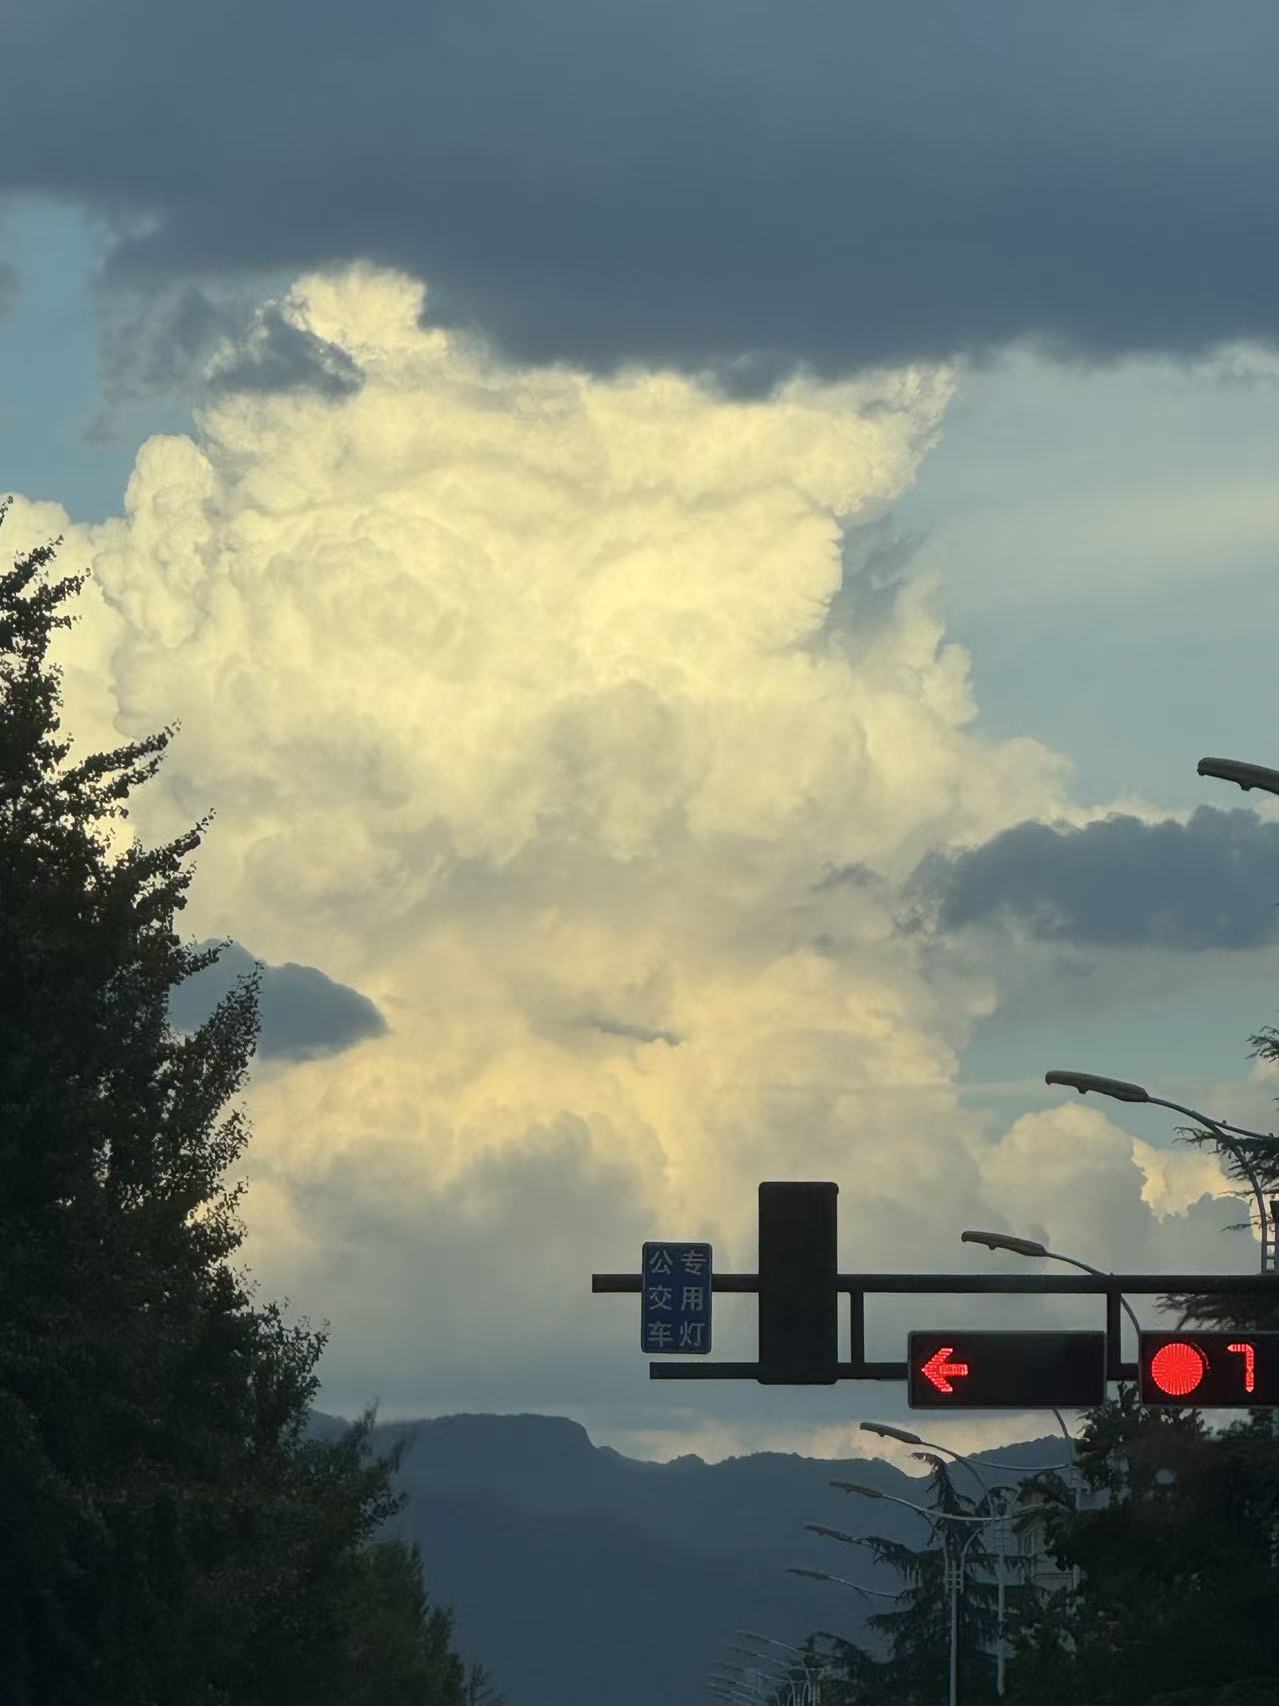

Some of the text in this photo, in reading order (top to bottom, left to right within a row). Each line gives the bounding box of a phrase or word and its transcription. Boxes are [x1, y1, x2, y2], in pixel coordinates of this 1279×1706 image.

[647, 1249, 673, 1347] 公交车
[680, 1248, 706, 1347] 专用灯
[1227, 1344, 1254, 1392] 7
